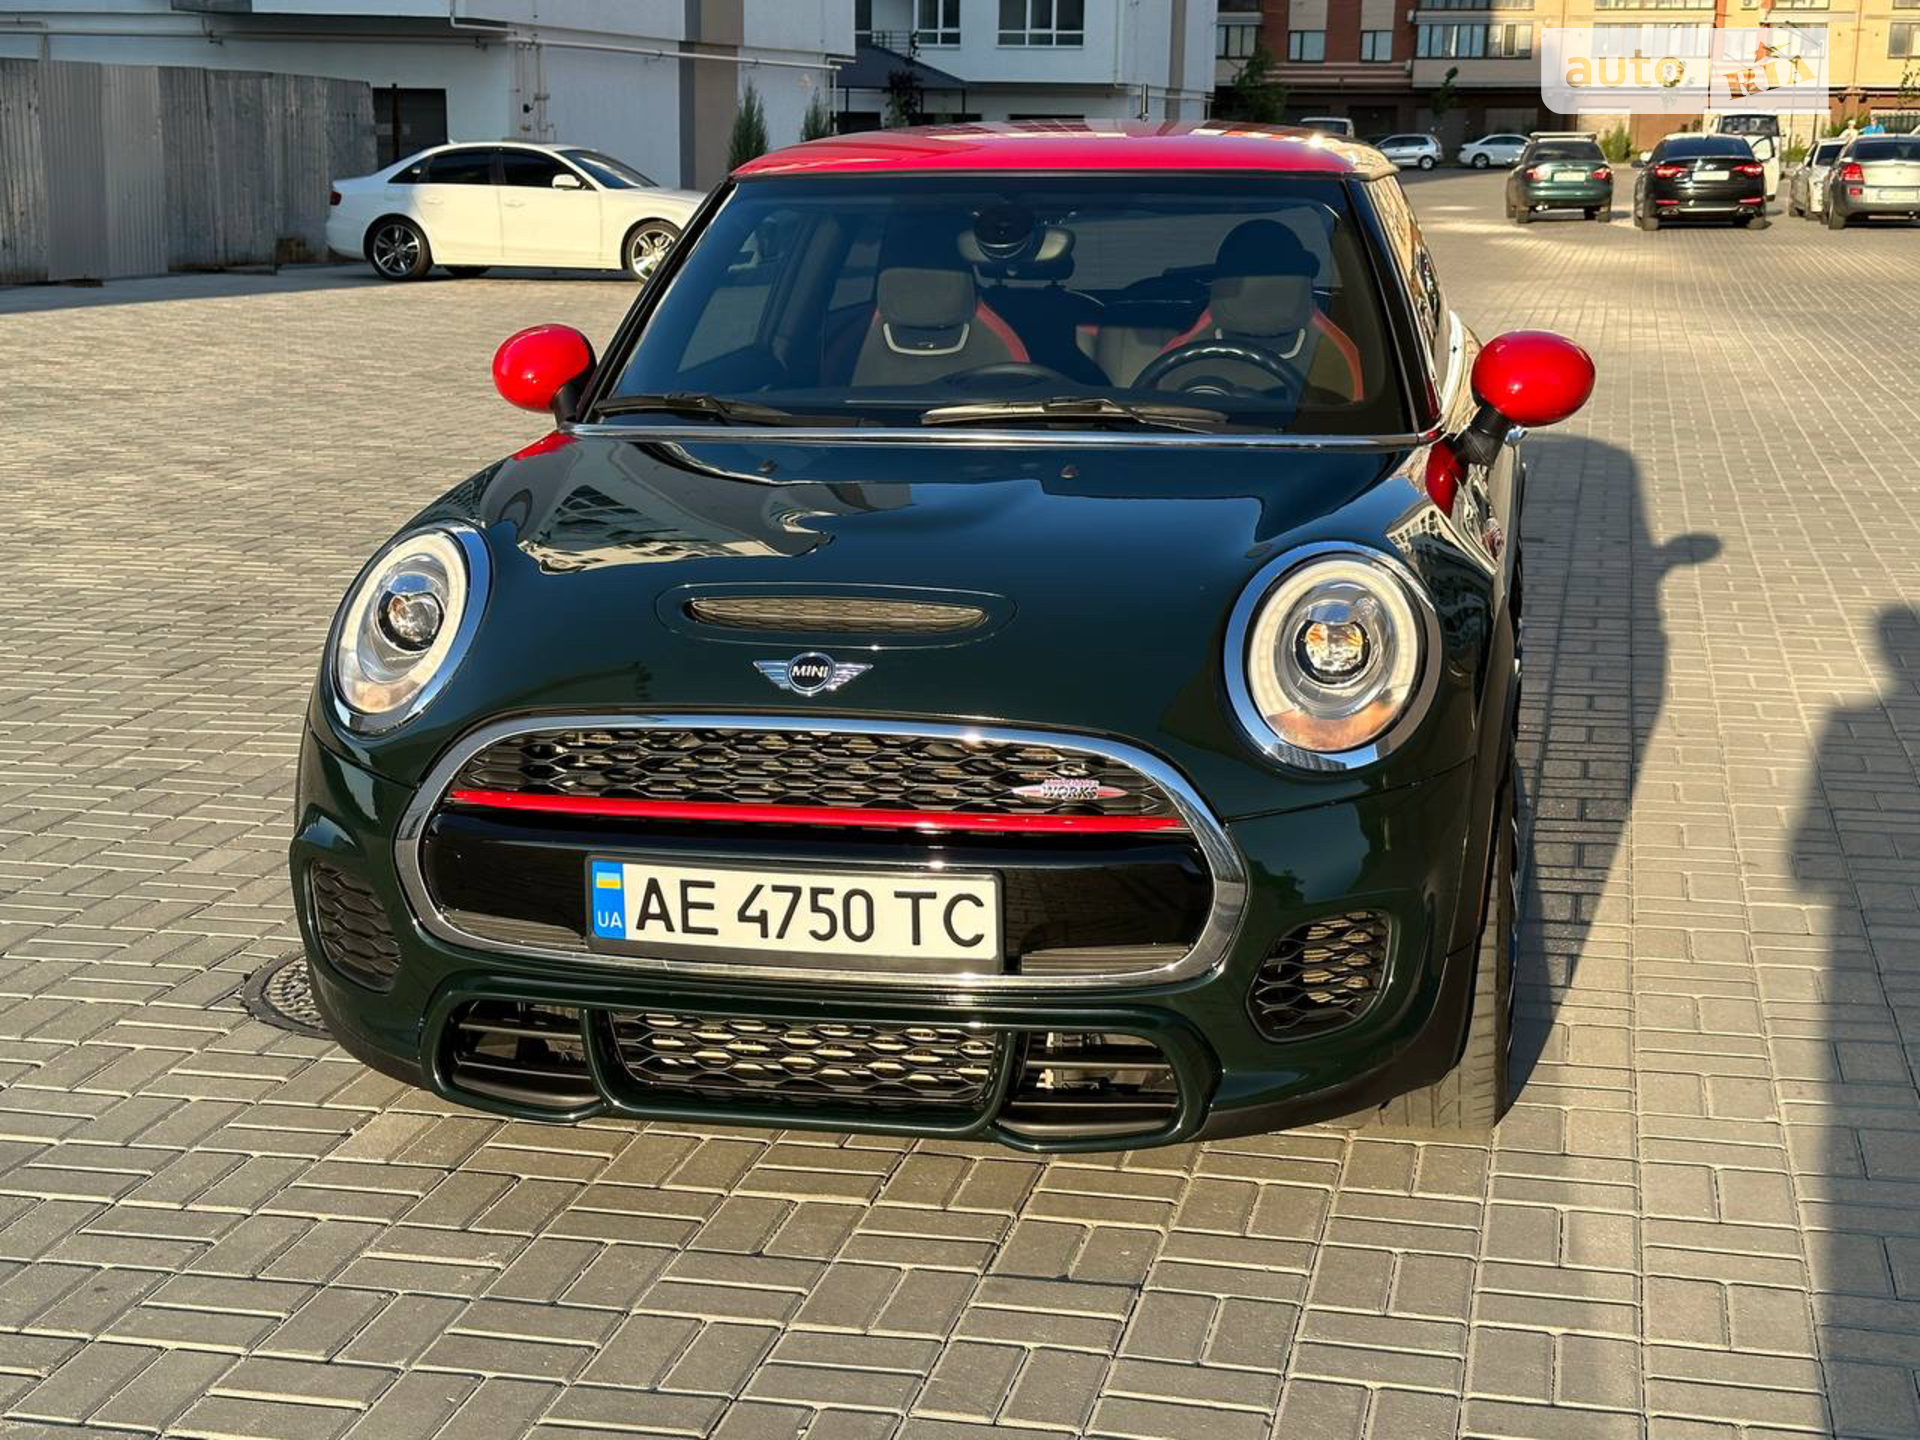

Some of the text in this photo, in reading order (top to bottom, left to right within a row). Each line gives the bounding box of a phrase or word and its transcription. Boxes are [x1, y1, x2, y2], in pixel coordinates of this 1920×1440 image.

[791, 665, 829, 678] MINI
[1043, 786, 1099, 799] WORKS
[597, 911, 623, 929] UA
[635, 877, 985, 948] AE 4750 TC
